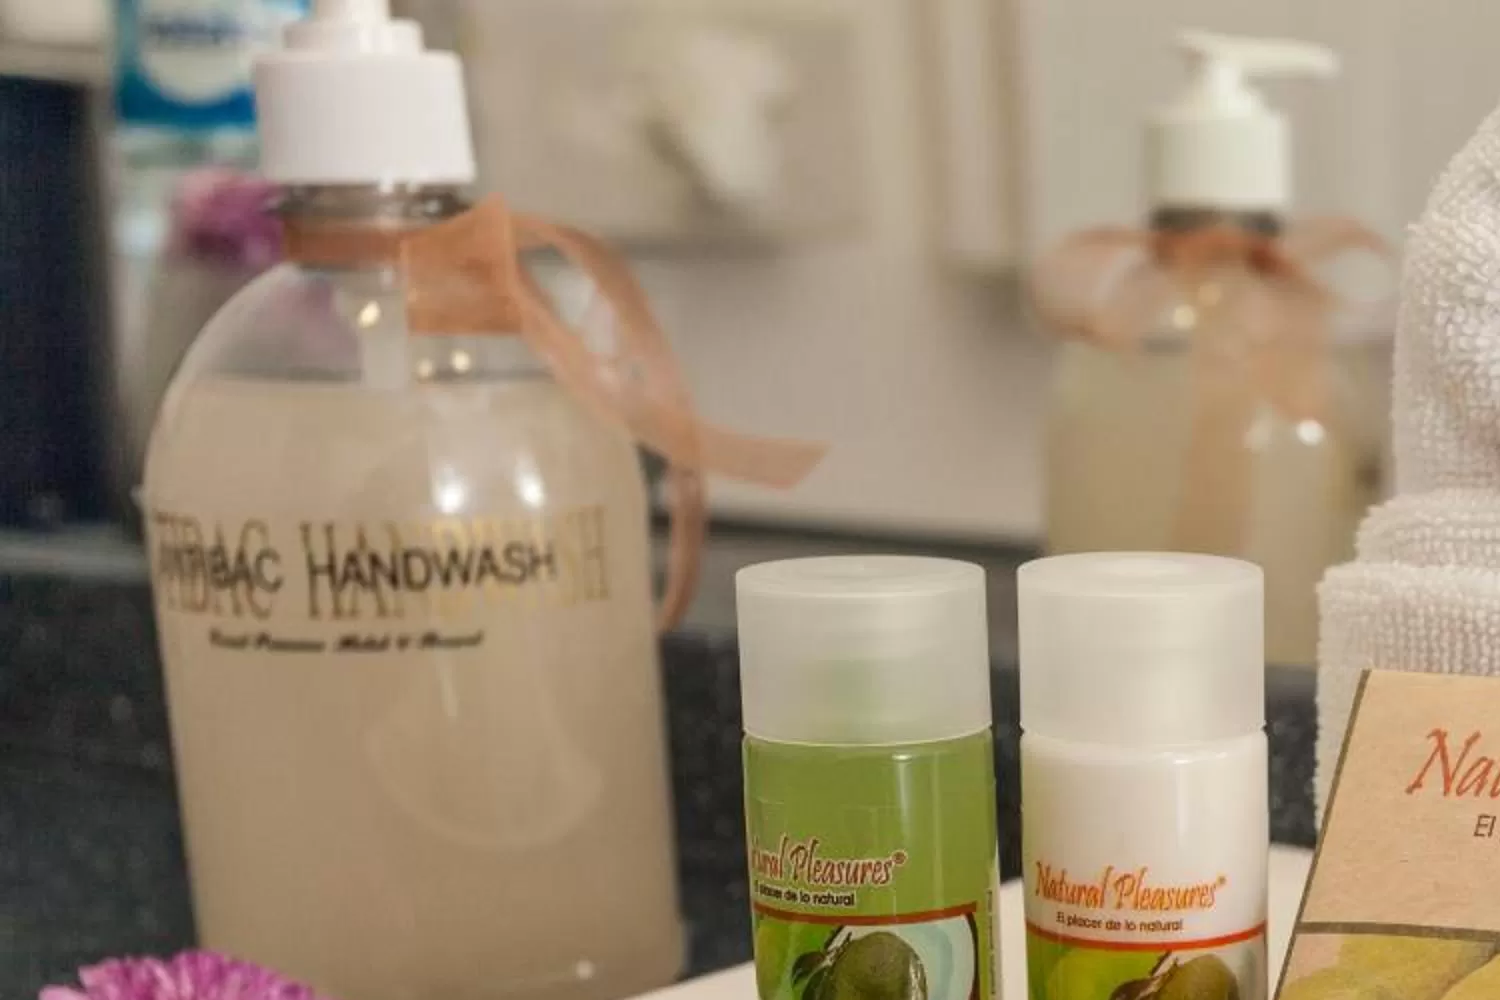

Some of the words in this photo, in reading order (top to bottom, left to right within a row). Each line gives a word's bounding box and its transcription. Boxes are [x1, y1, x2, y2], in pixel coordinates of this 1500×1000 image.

[1473, 814, 1498, 839] El
[1035, 861, 1113, 909] Natural
[812, 892, 856, 906] natural
[1066, 913, 1103, 929] placer
[1105, 917, 1123, 931] de
[1124, 918, 1137, 932] lo
[1139, 918, 1185, 933] natural
